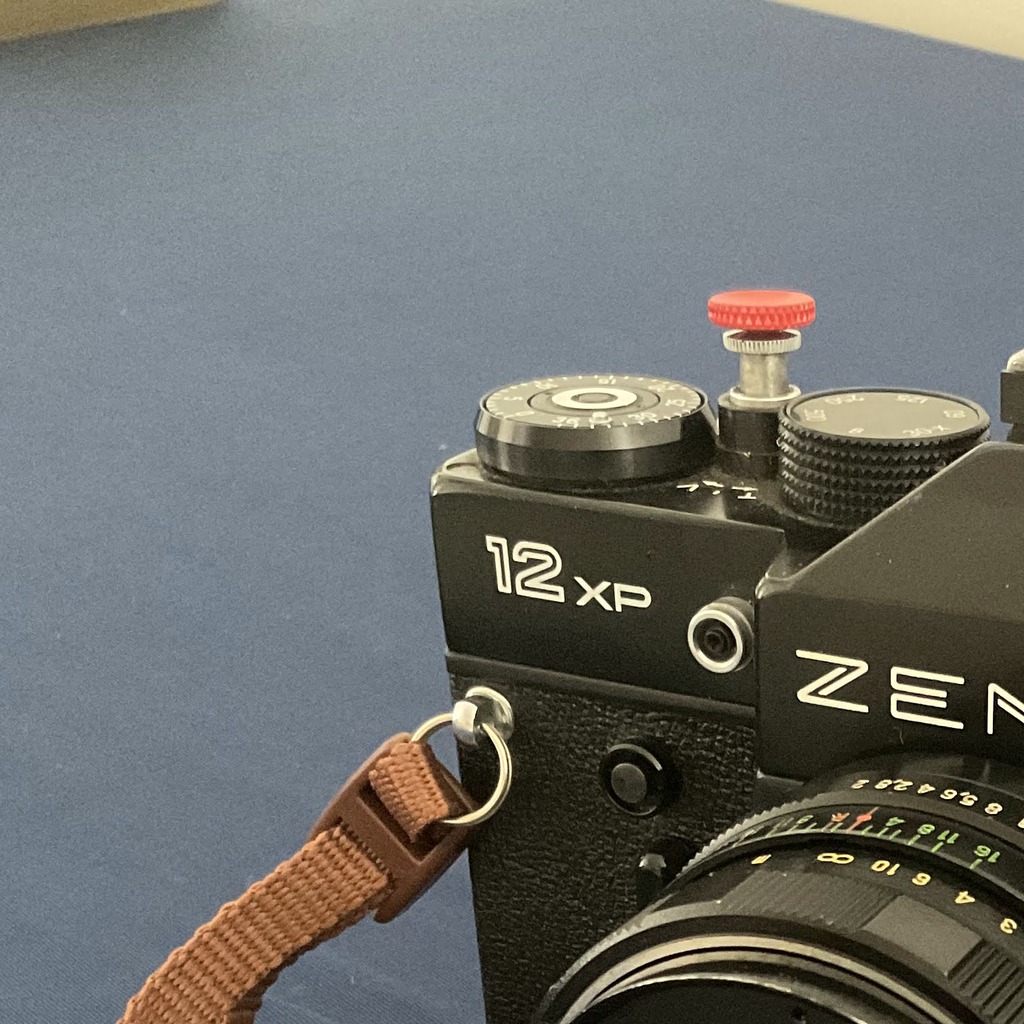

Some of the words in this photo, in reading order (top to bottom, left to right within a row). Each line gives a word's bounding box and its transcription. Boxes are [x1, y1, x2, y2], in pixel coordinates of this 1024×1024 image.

[485, 535, 565, 603] 12
[573, 576, 652, 613] XP
[917, 783, 936, 794] 4
[984, 802, 1003, 815] 8
[916, 823, 936, 836] 8
[936, 829, 960, 845] 11
[973, 844, 1001, 864] 16
[870, 858, 901, 877] 10
[911, 872, 931, 887] 6
[954, 889, 976, 906] 4
[999, 917, 1018, 935] 3
